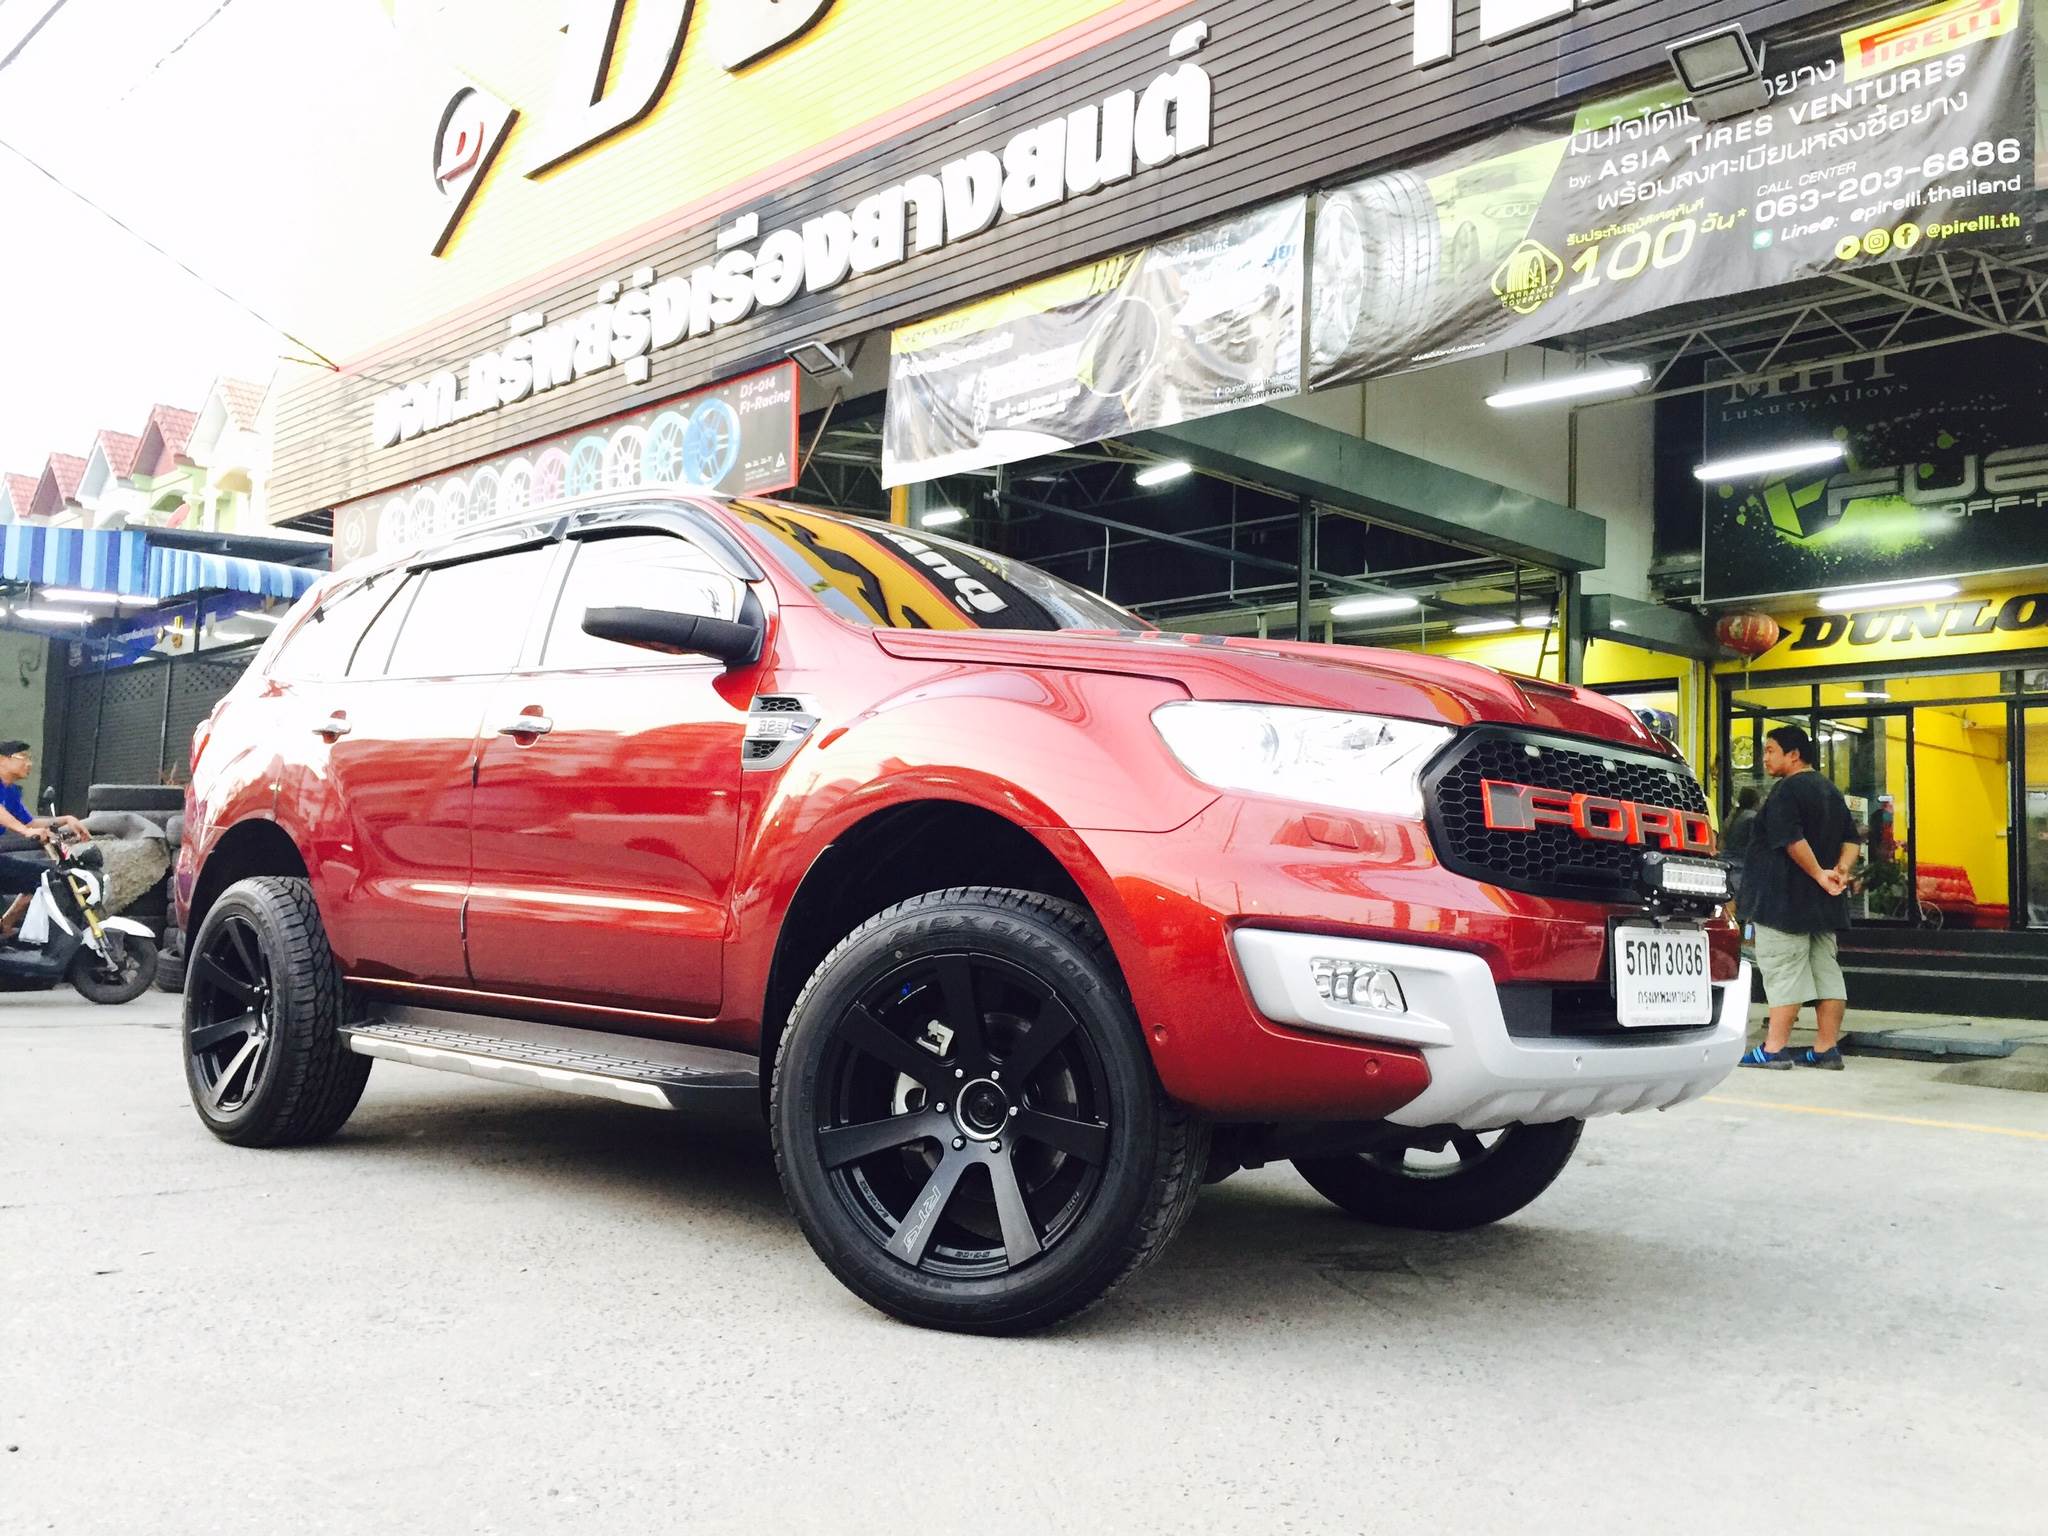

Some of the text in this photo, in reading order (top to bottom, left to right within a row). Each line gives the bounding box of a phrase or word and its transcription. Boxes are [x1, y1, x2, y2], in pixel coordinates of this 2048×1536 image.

[1859, 0, 2000, 69] PIRELLI
[1568, 53, 1967, 188] by: ASIA TIRES VENTURES
[1597, 91, 1969, 210] พร้อมลงทะเบียนหลังซื้อยาง
[1755, 138, 2022, 223] 063-203-6886
[1756, 161, 1858, 197] CALL CENTER
[1850, 174, 2022, 223] @pirelli.thailand
[1926, 212, 2021, 239] @pirelli.th
[1568, 218, 1697, 296] 100
[1500, 283, 1557, 302] WARRANTY
[1502, 292, 1555, 308] COVERAGE
[1825, 382, 1910, 406] Alloys
[1481, 778, 1718, 855] FORD
[1625, 939, 1703, 977] 5กต 3036
